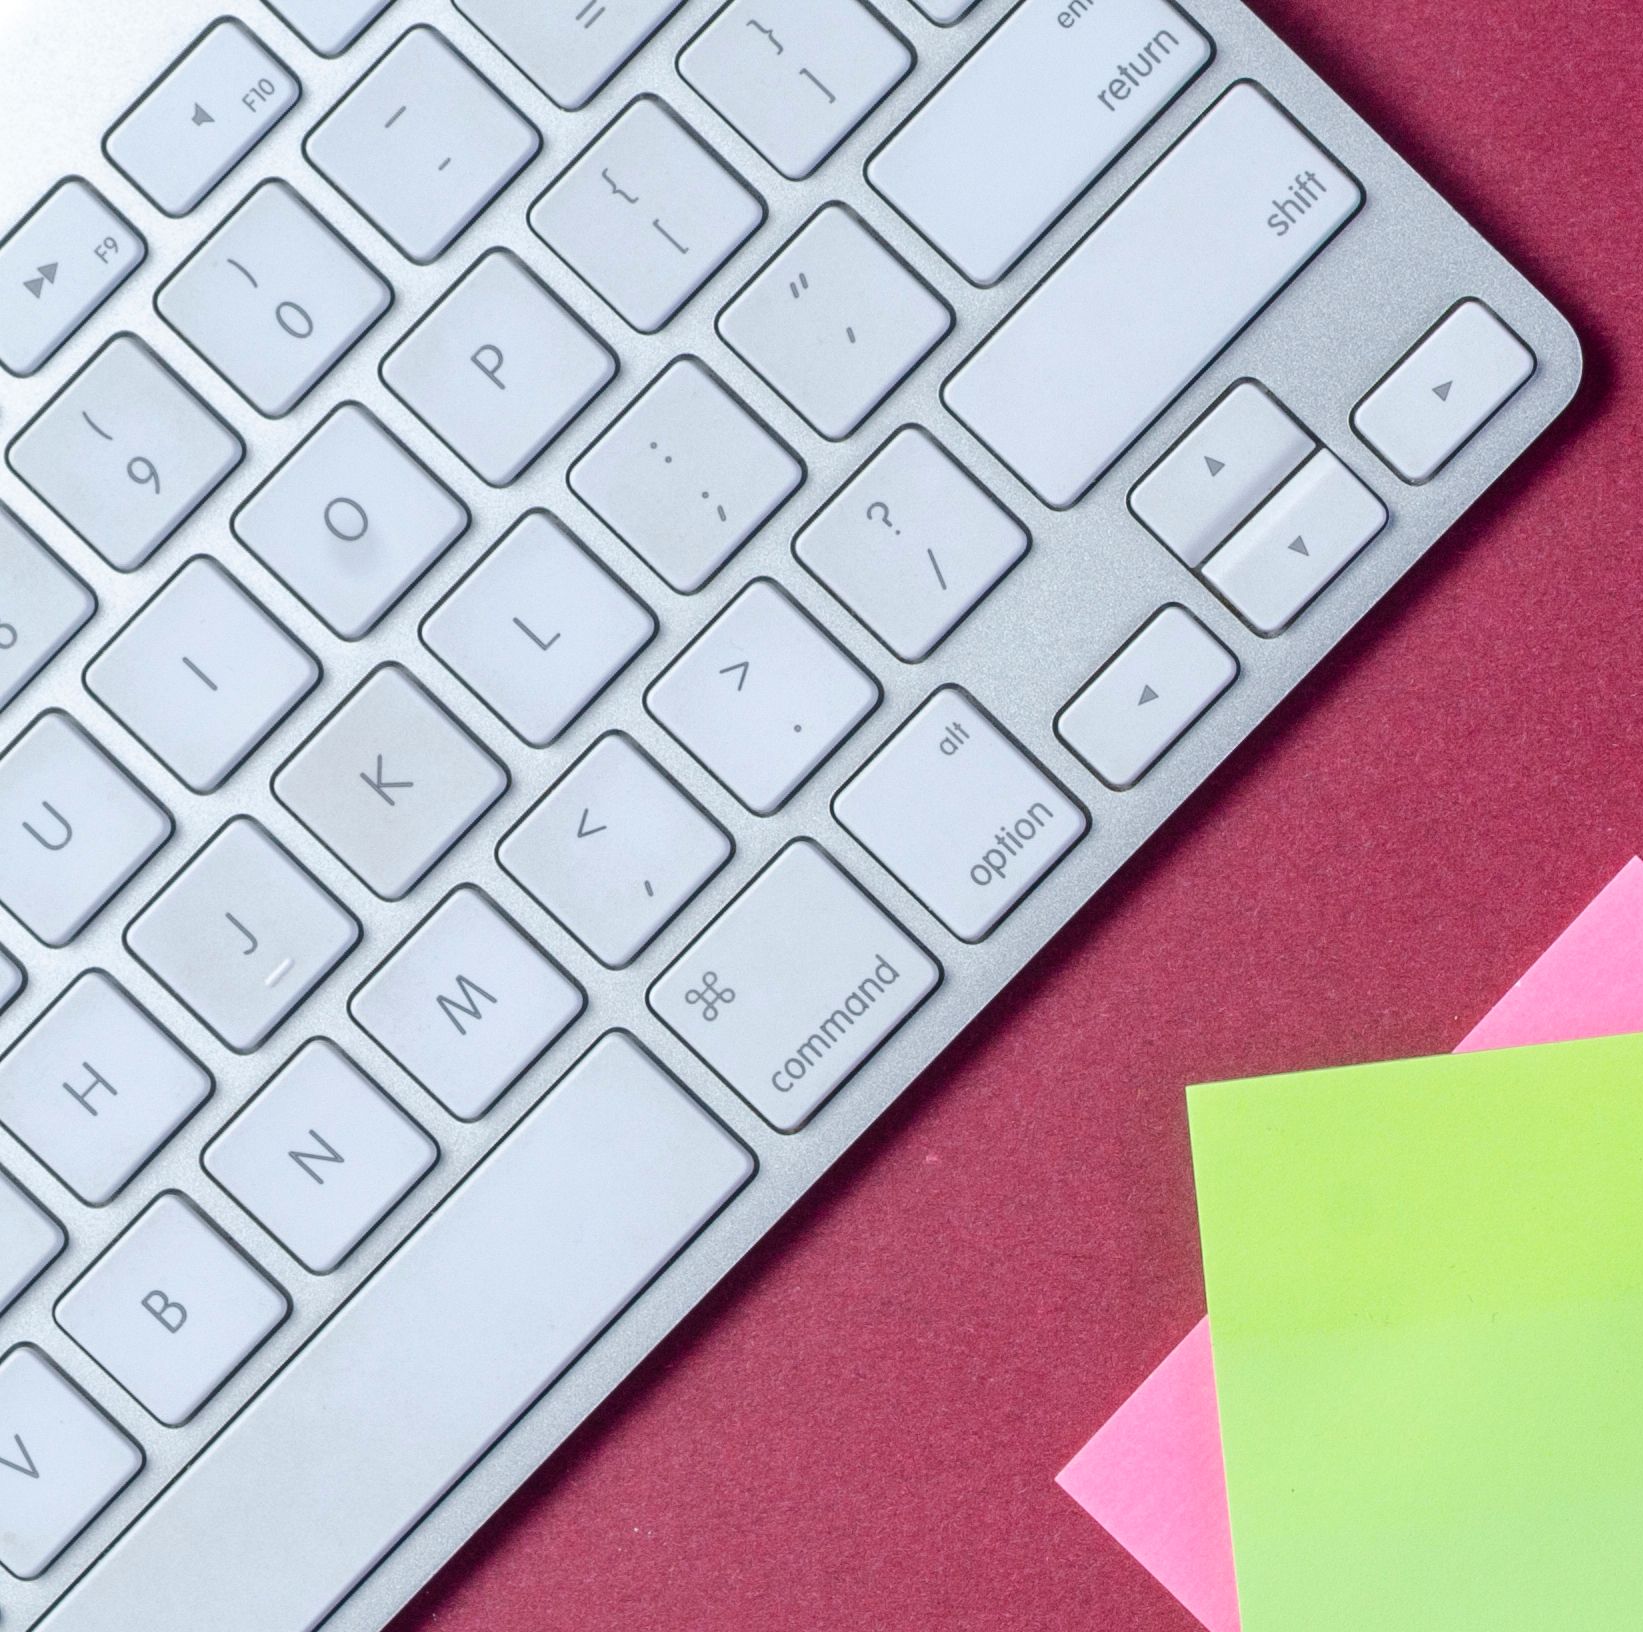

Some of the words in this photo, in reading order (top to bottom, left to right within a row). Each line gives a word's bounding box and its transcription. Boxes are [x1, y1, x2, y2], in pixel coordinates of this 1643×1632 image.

[1056, 0, 1094, 29] en
[1098, 30, 1179, 111] return
[241, 77, 276, 113] F10
[1267, 171, 1326, 236] shift
[93, 236, 119, 265] F9
[274, 300, 314, 340] 0
[470, 343, 506, 391] P
[126, 455, 161, 495] 9
[323, 496, 369, 543] O
[512, 616, 562, 652] L
[181, 656, 219, 692] I
[939, 721, 970, 756] alt
[359, 753, 414, 807] K
[21, 800, 73, 852] U
[971, 803, 1053, 886] option
[224, 911, 259, 956] J
[435, 974, 498, 1036] M
[772, 955, 899, 1092] command
[62, 1061, 118, 1117] H
[287, 1128, 345, 1185] N
[140, 1289, 188, 1334] B
[0, 1433, 40, 1480] V
